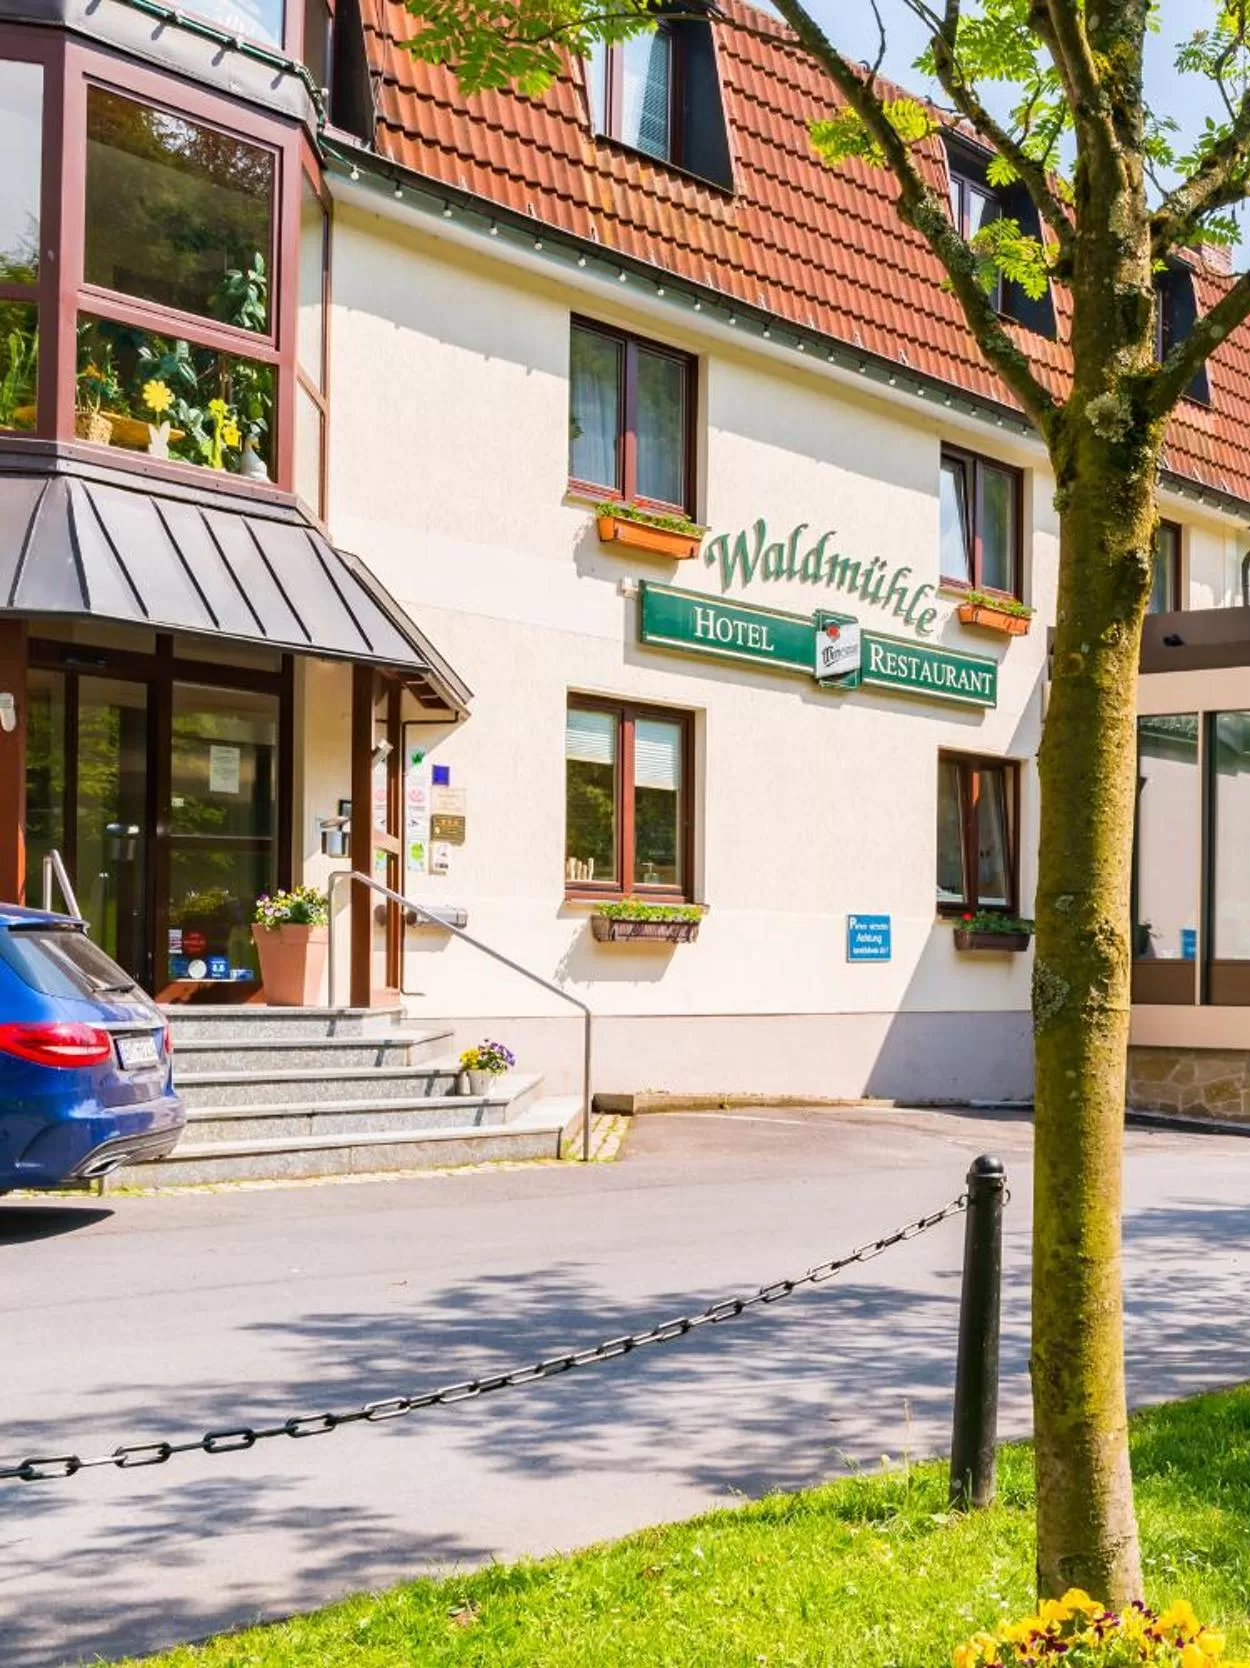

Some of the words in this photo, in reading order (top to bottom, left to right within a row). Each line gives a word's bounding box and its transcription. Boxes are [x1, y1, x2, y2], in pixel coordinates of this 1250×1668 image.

[703, 518, 937, 634] Waldmühle
[693, 606, 775, 651] HOTEL
[869, 642, 992, 694] RESTAURANT
